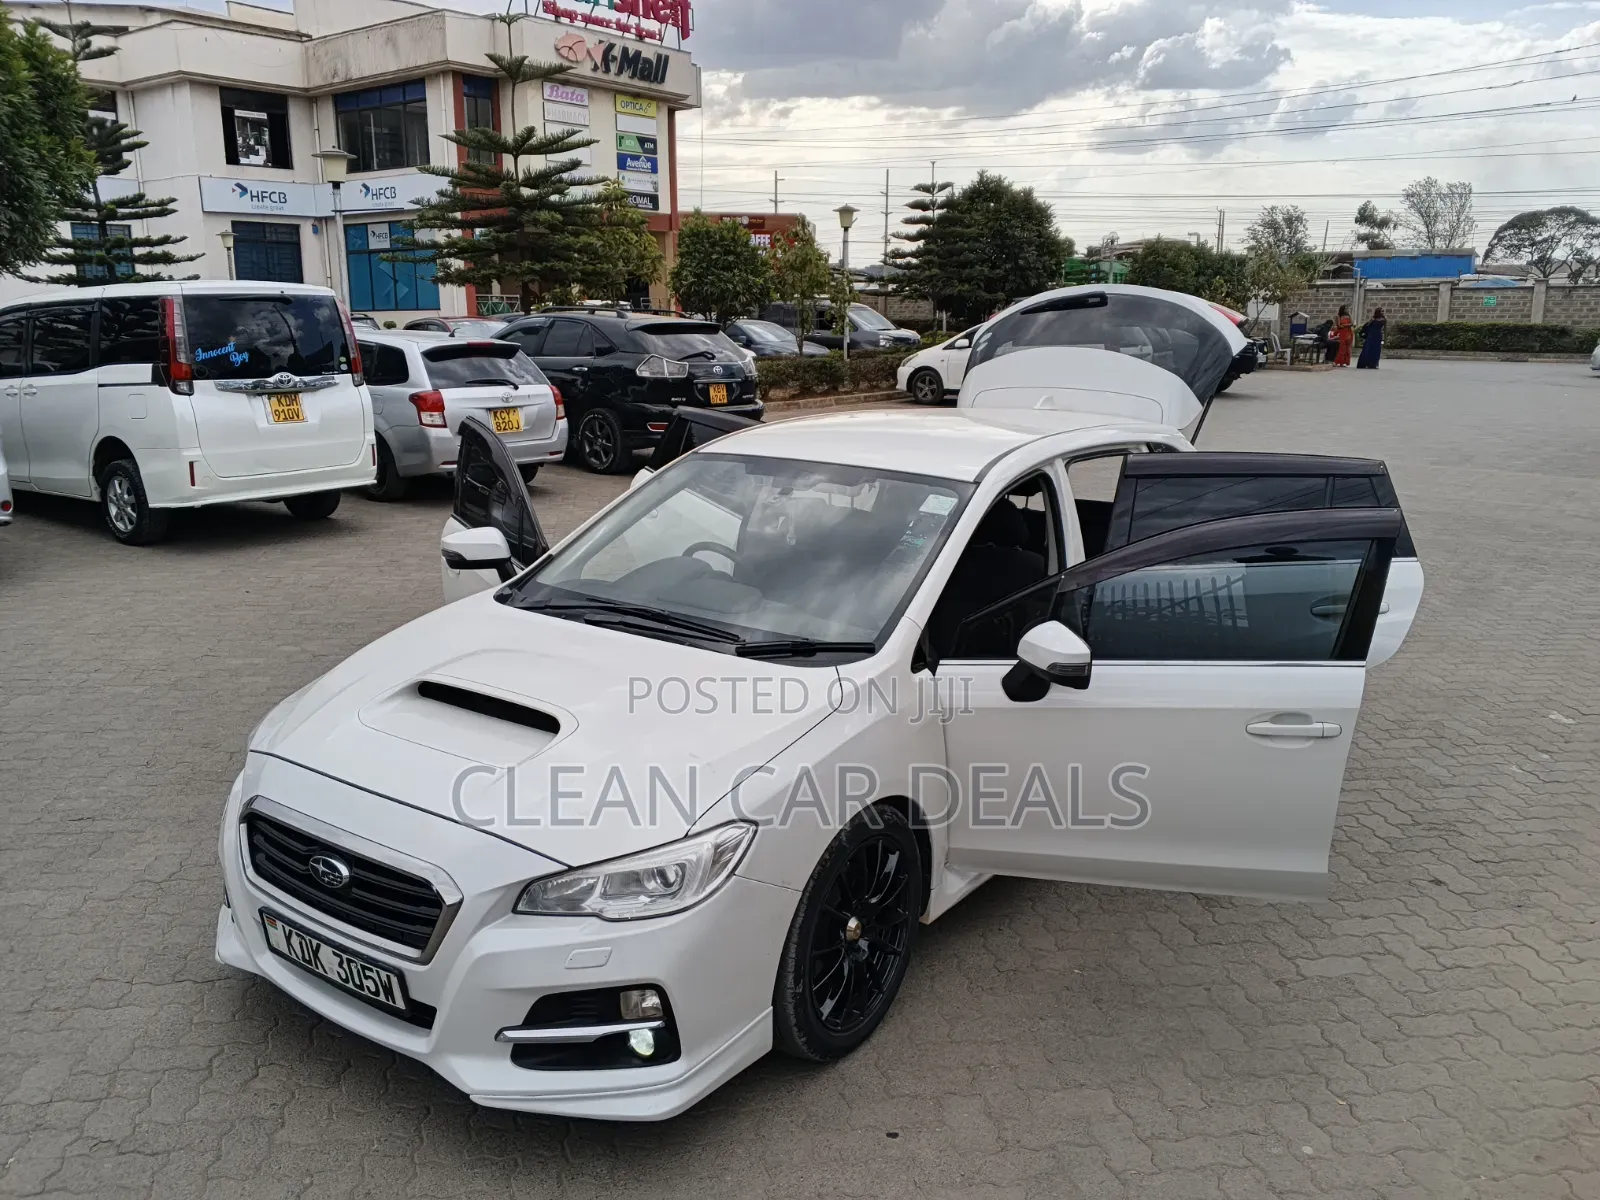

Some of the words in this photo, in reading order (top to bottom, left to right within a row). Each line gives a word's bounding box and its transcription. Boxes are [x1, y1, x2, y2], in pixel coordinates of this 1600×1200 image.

[543, 0, 578, 23] Shop
[547, 84, 585, 103] Bata
[620, 99, 644, 111] OPTICA
[546, 108, 587, 124] PHARMACY
[626, 157, 652, 169] Avenue
[250, 190, 287, 204] HFCB
[371, 186, 397, 201] HFCB
[195, 341, 236, 361] Innocent
[230, 351, 249, 367] Boy
[274, 408, 300, 420] 910V
[493, 409, 511, 421] KCY
[495, 420, 520, 431] 820J
[282, 925, 328, 975] KDK
[332, 952, 397, 1005] 305W
